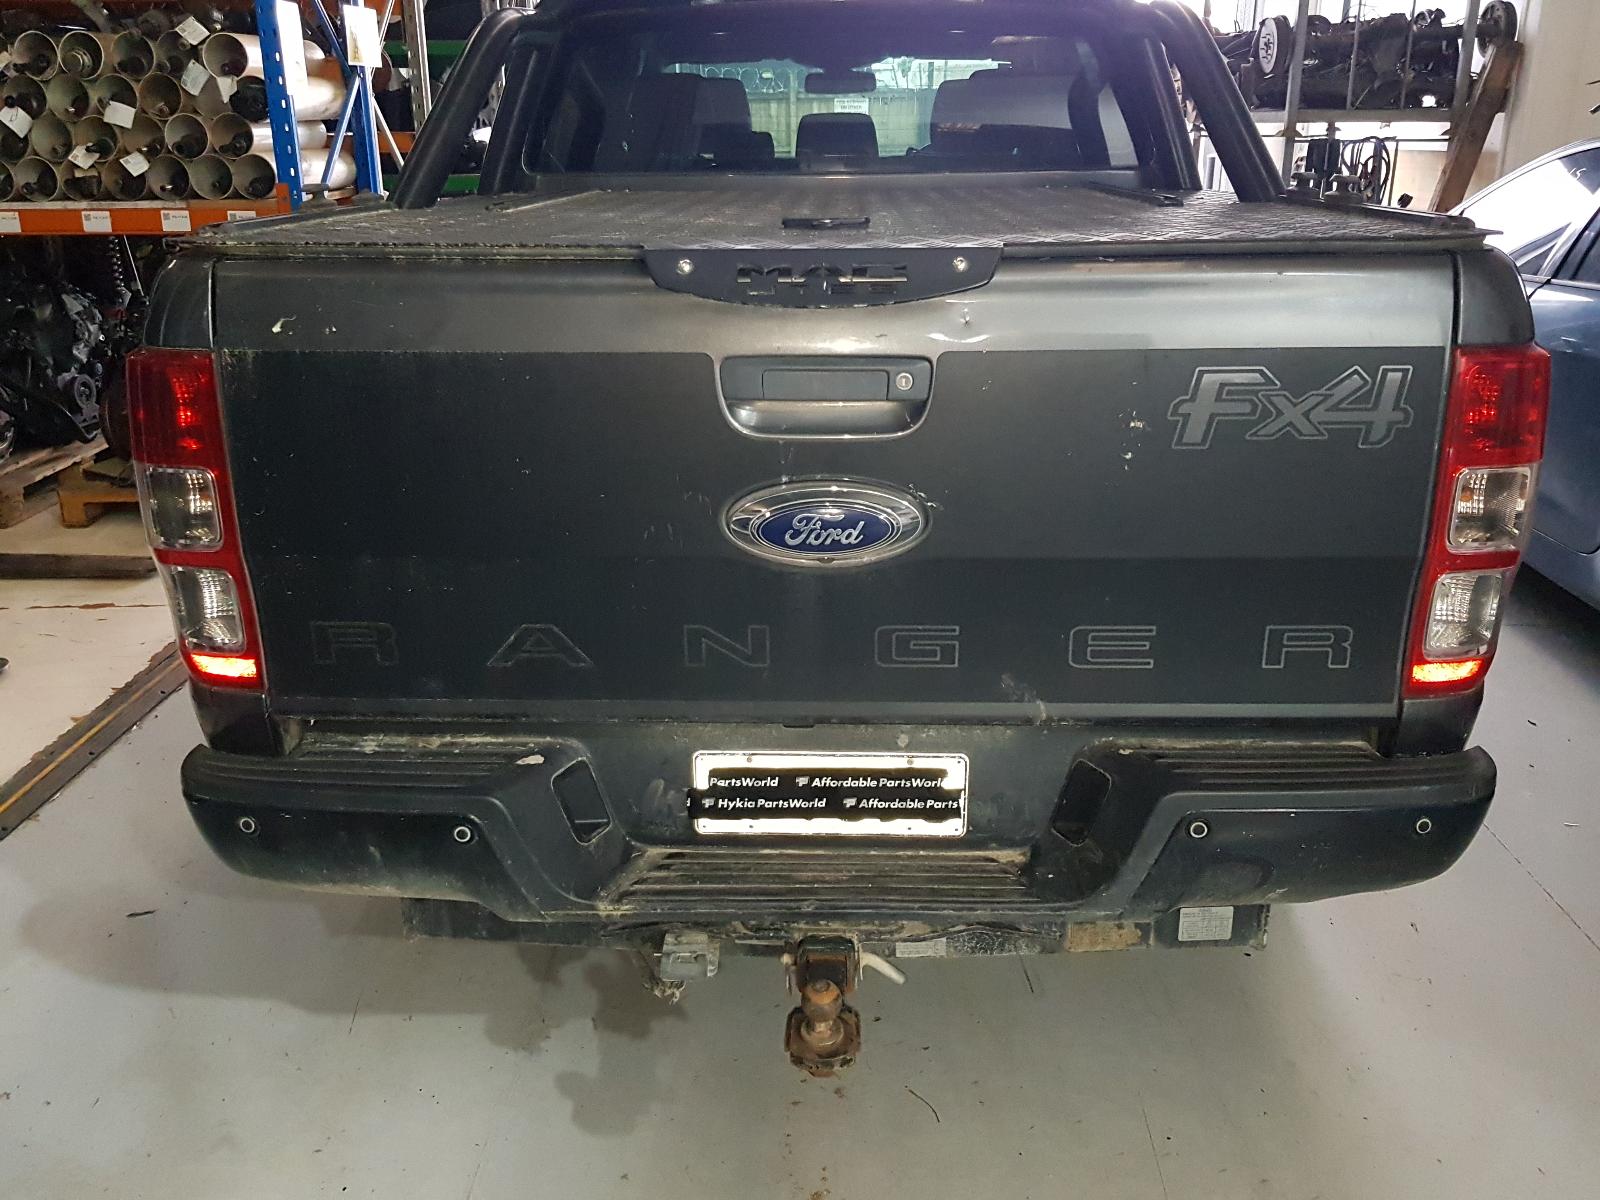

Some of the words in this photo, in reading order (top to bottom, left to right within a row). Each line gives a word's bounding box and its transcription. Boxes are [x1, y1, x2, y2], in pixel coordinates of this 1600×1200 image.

[784, 513, 865, 546] Ford
[310, 621, 1354, 669] RANGER
[709, 776, 779, 787] PartsWorld
[811, 776, 877, 788] Affordable
[718, 797, 756, 811] Hykia
[757, 797, 827, 809] PartsWorld
[859, 798, 924, 809] Affordable
